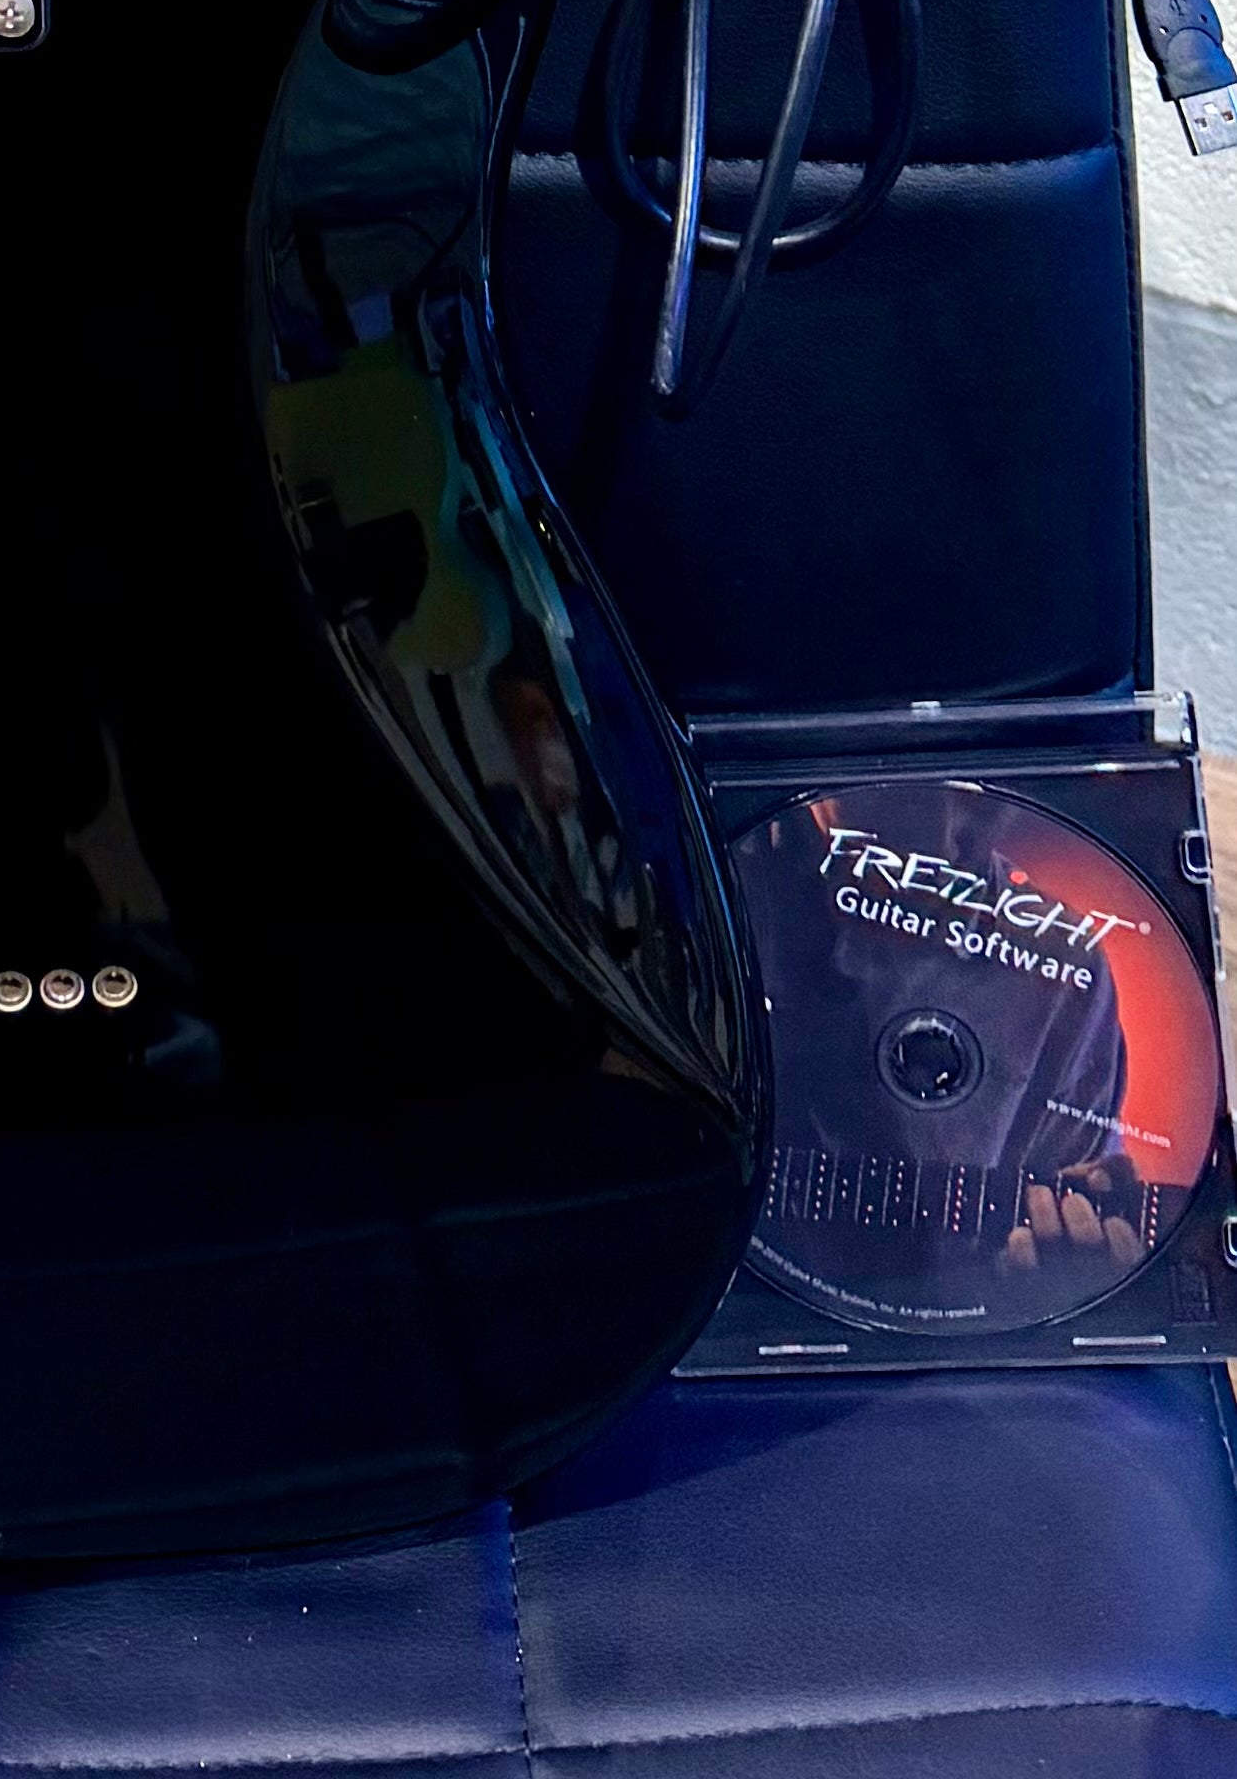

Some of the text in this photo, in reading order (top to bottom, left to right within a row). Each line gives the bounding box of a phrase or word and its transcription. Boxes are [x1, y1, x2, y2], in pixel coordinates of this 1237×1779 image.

[819, 828, 1135, 952] FRETLIGHT
[834, 885, 1093, 989] Guitar Software
